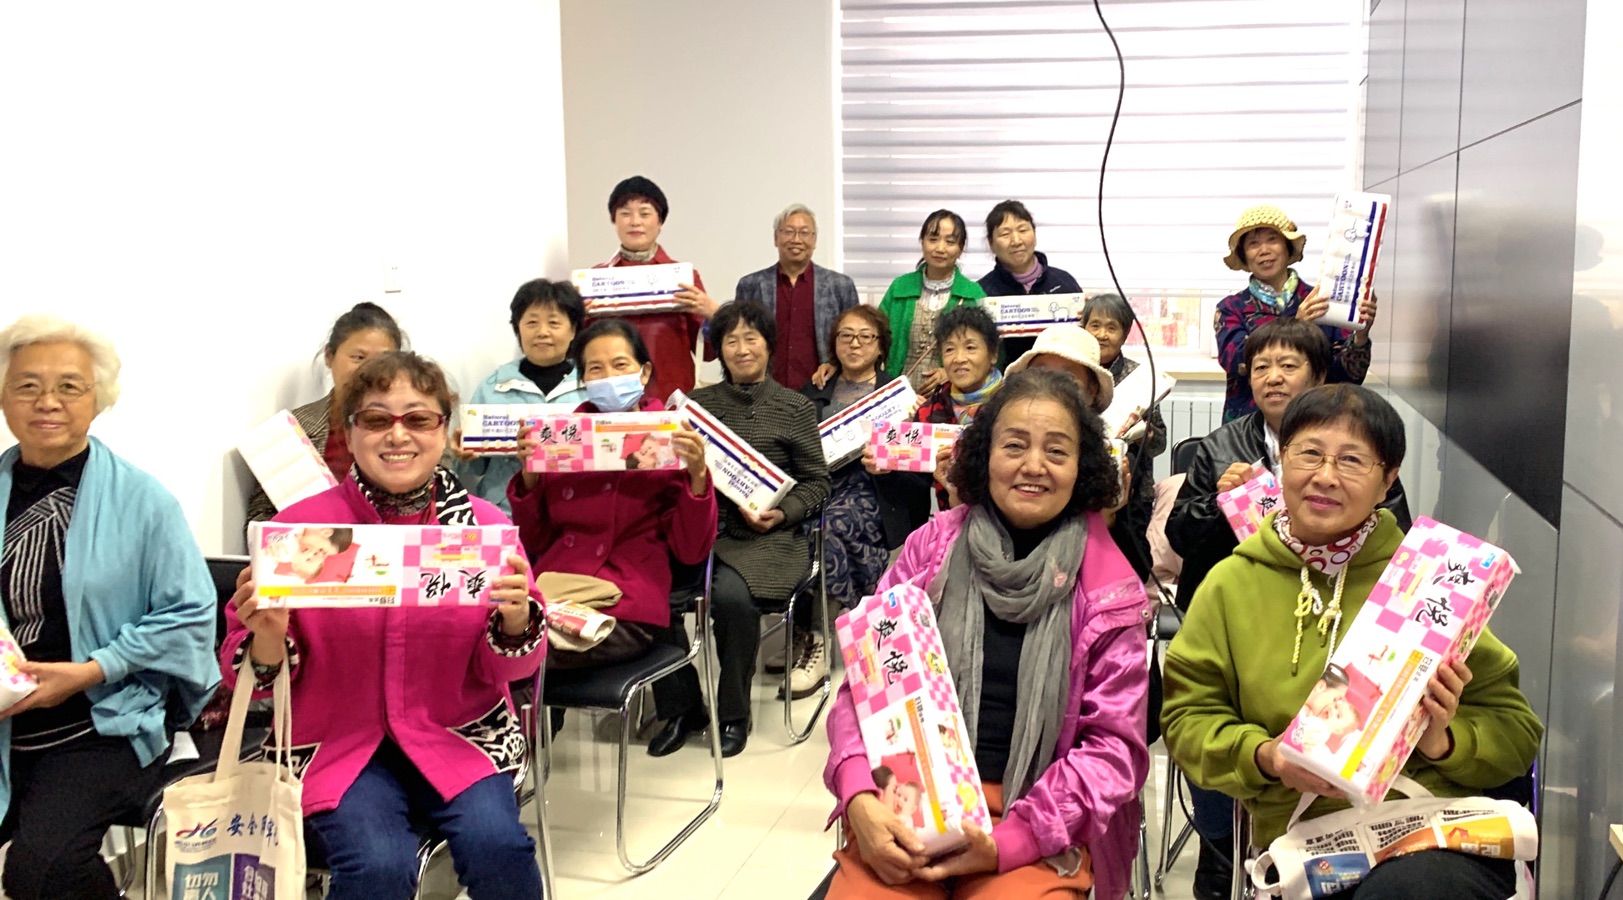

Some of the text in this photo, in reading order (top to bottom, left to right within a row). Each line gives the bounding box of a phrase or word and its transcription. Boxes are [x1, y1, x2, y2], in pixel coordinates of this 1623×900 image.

[1336, 263, 1349, 302] CARTOON
[540, 424, 582, 444] 爽悦
[885, 426, 922, 445] 爽悦
[722, 467, 754, 494] CARTOON
[420, 569, 488, 599] 爽悦
[1415, 558, 1475, 627] 爽悦
[872, 617, 909, 685] 爽悦
